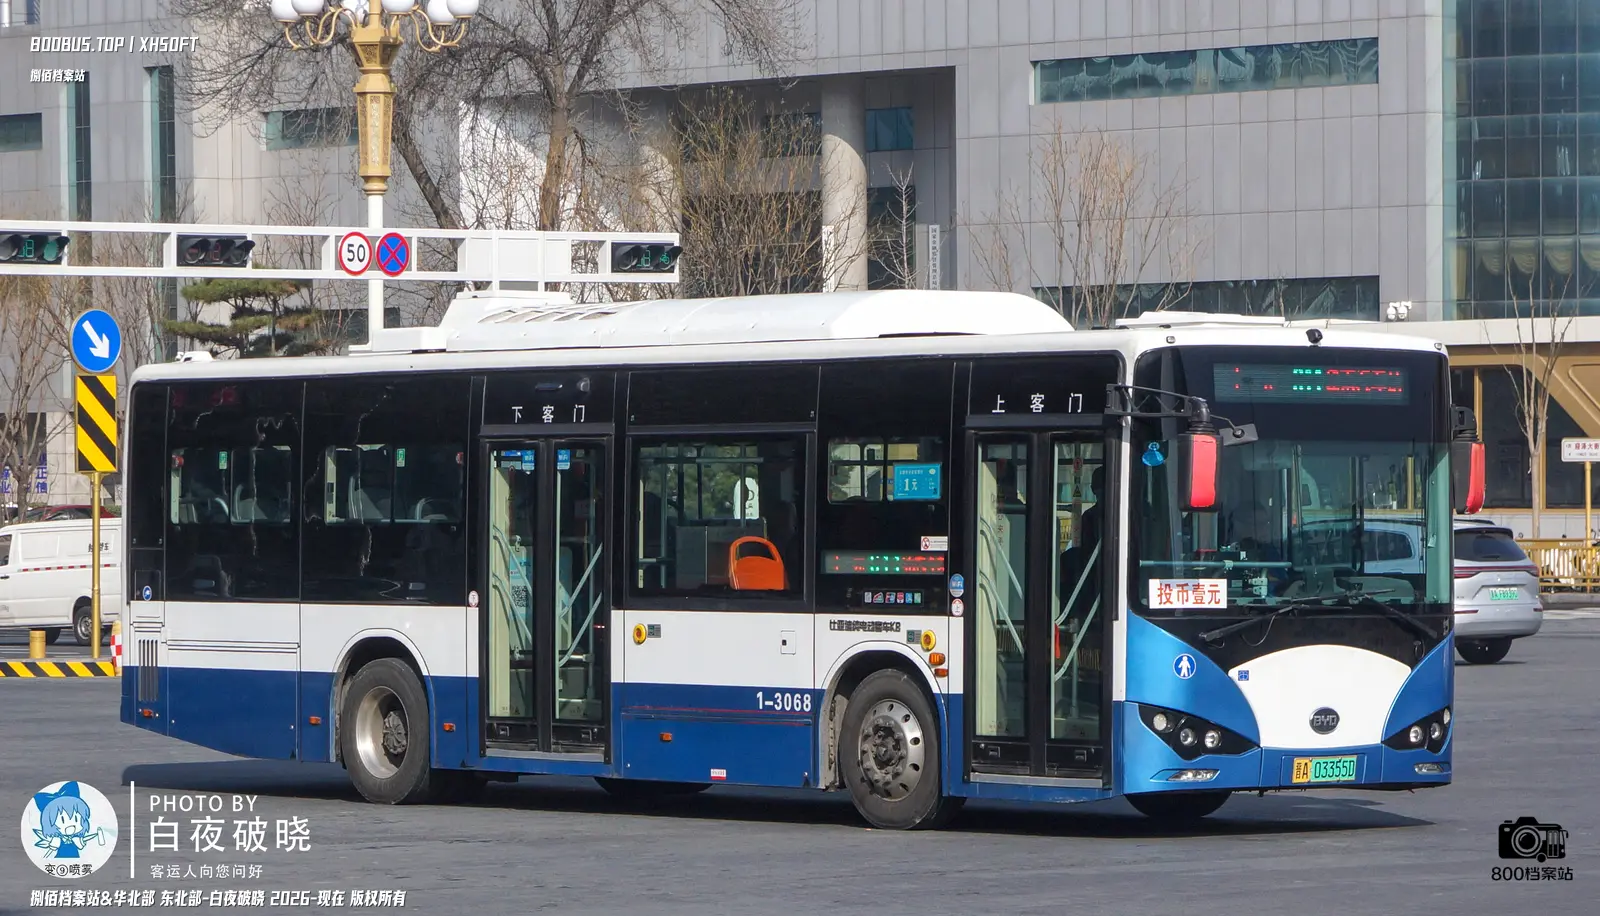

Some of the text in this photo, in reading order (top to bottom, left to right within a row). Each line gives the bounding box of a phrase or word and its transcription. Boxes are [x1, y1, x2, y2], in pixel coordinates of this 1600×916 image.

[347, 243, 366, 263] 50
[991, 392, 1083, 413] 上客门
[511, 404, 585, 423] 下客门
[1157, 582, 1221, 605] 投币壹元
[756, 691, 811, 712] 1-3068
[1313, 714, 1337, 727] BYD
